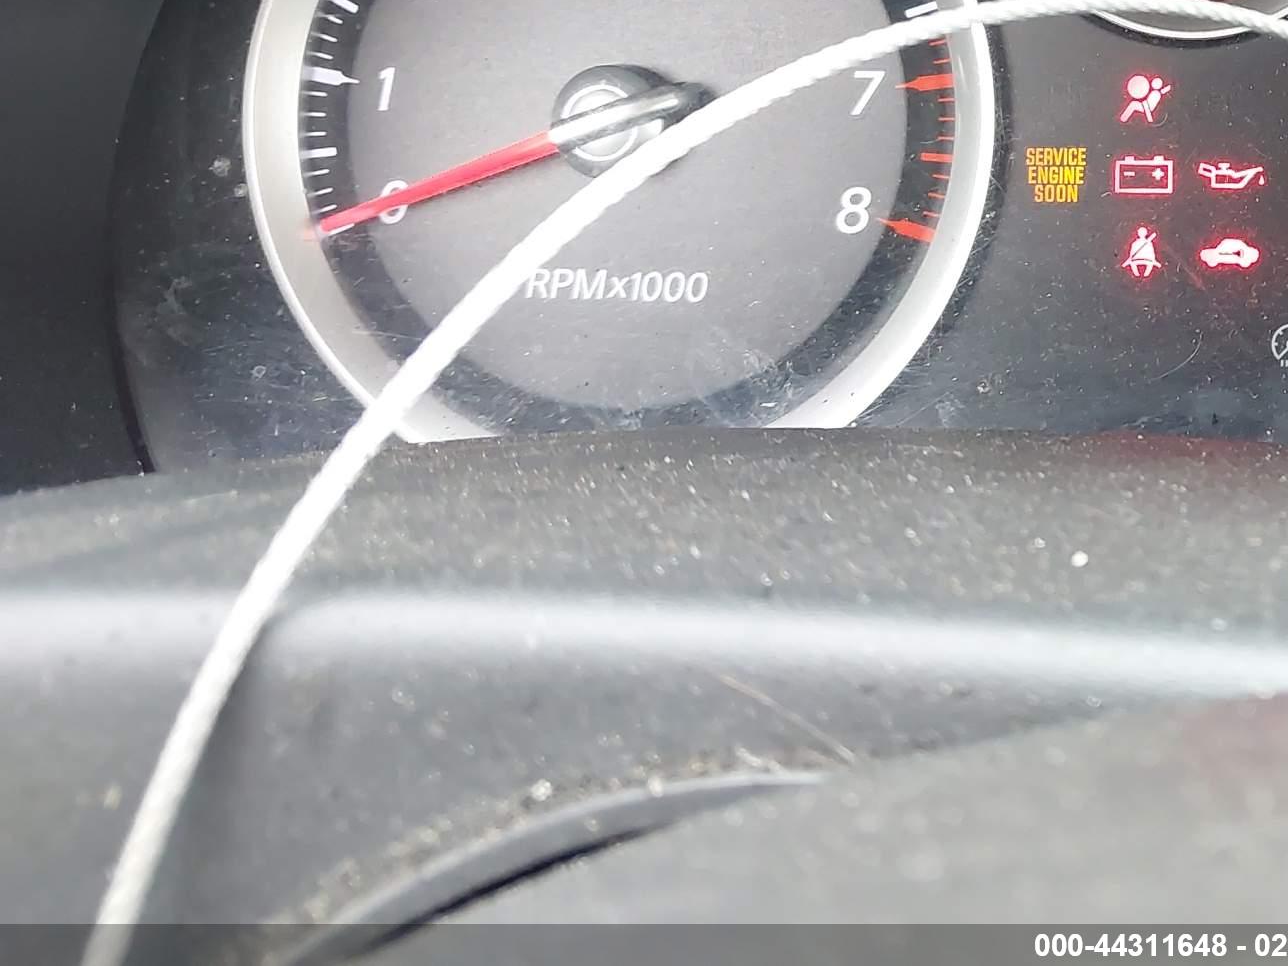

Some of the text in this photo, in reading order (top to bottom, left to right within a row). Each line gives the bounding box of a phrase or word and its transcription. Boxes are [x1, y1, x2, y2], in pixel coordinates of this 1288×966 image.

[376, 68, 396, 111] 1
[849, 70, 887, 116] 7
[1026, 147, 1087, 166] SERVICE
[1028, 166, 1085, 185] ENGINE
[836, 186, 872, 233] 8
[1034, 185, 1079, 203] SOON
[524, 267, 709, 303] RPMx1000
